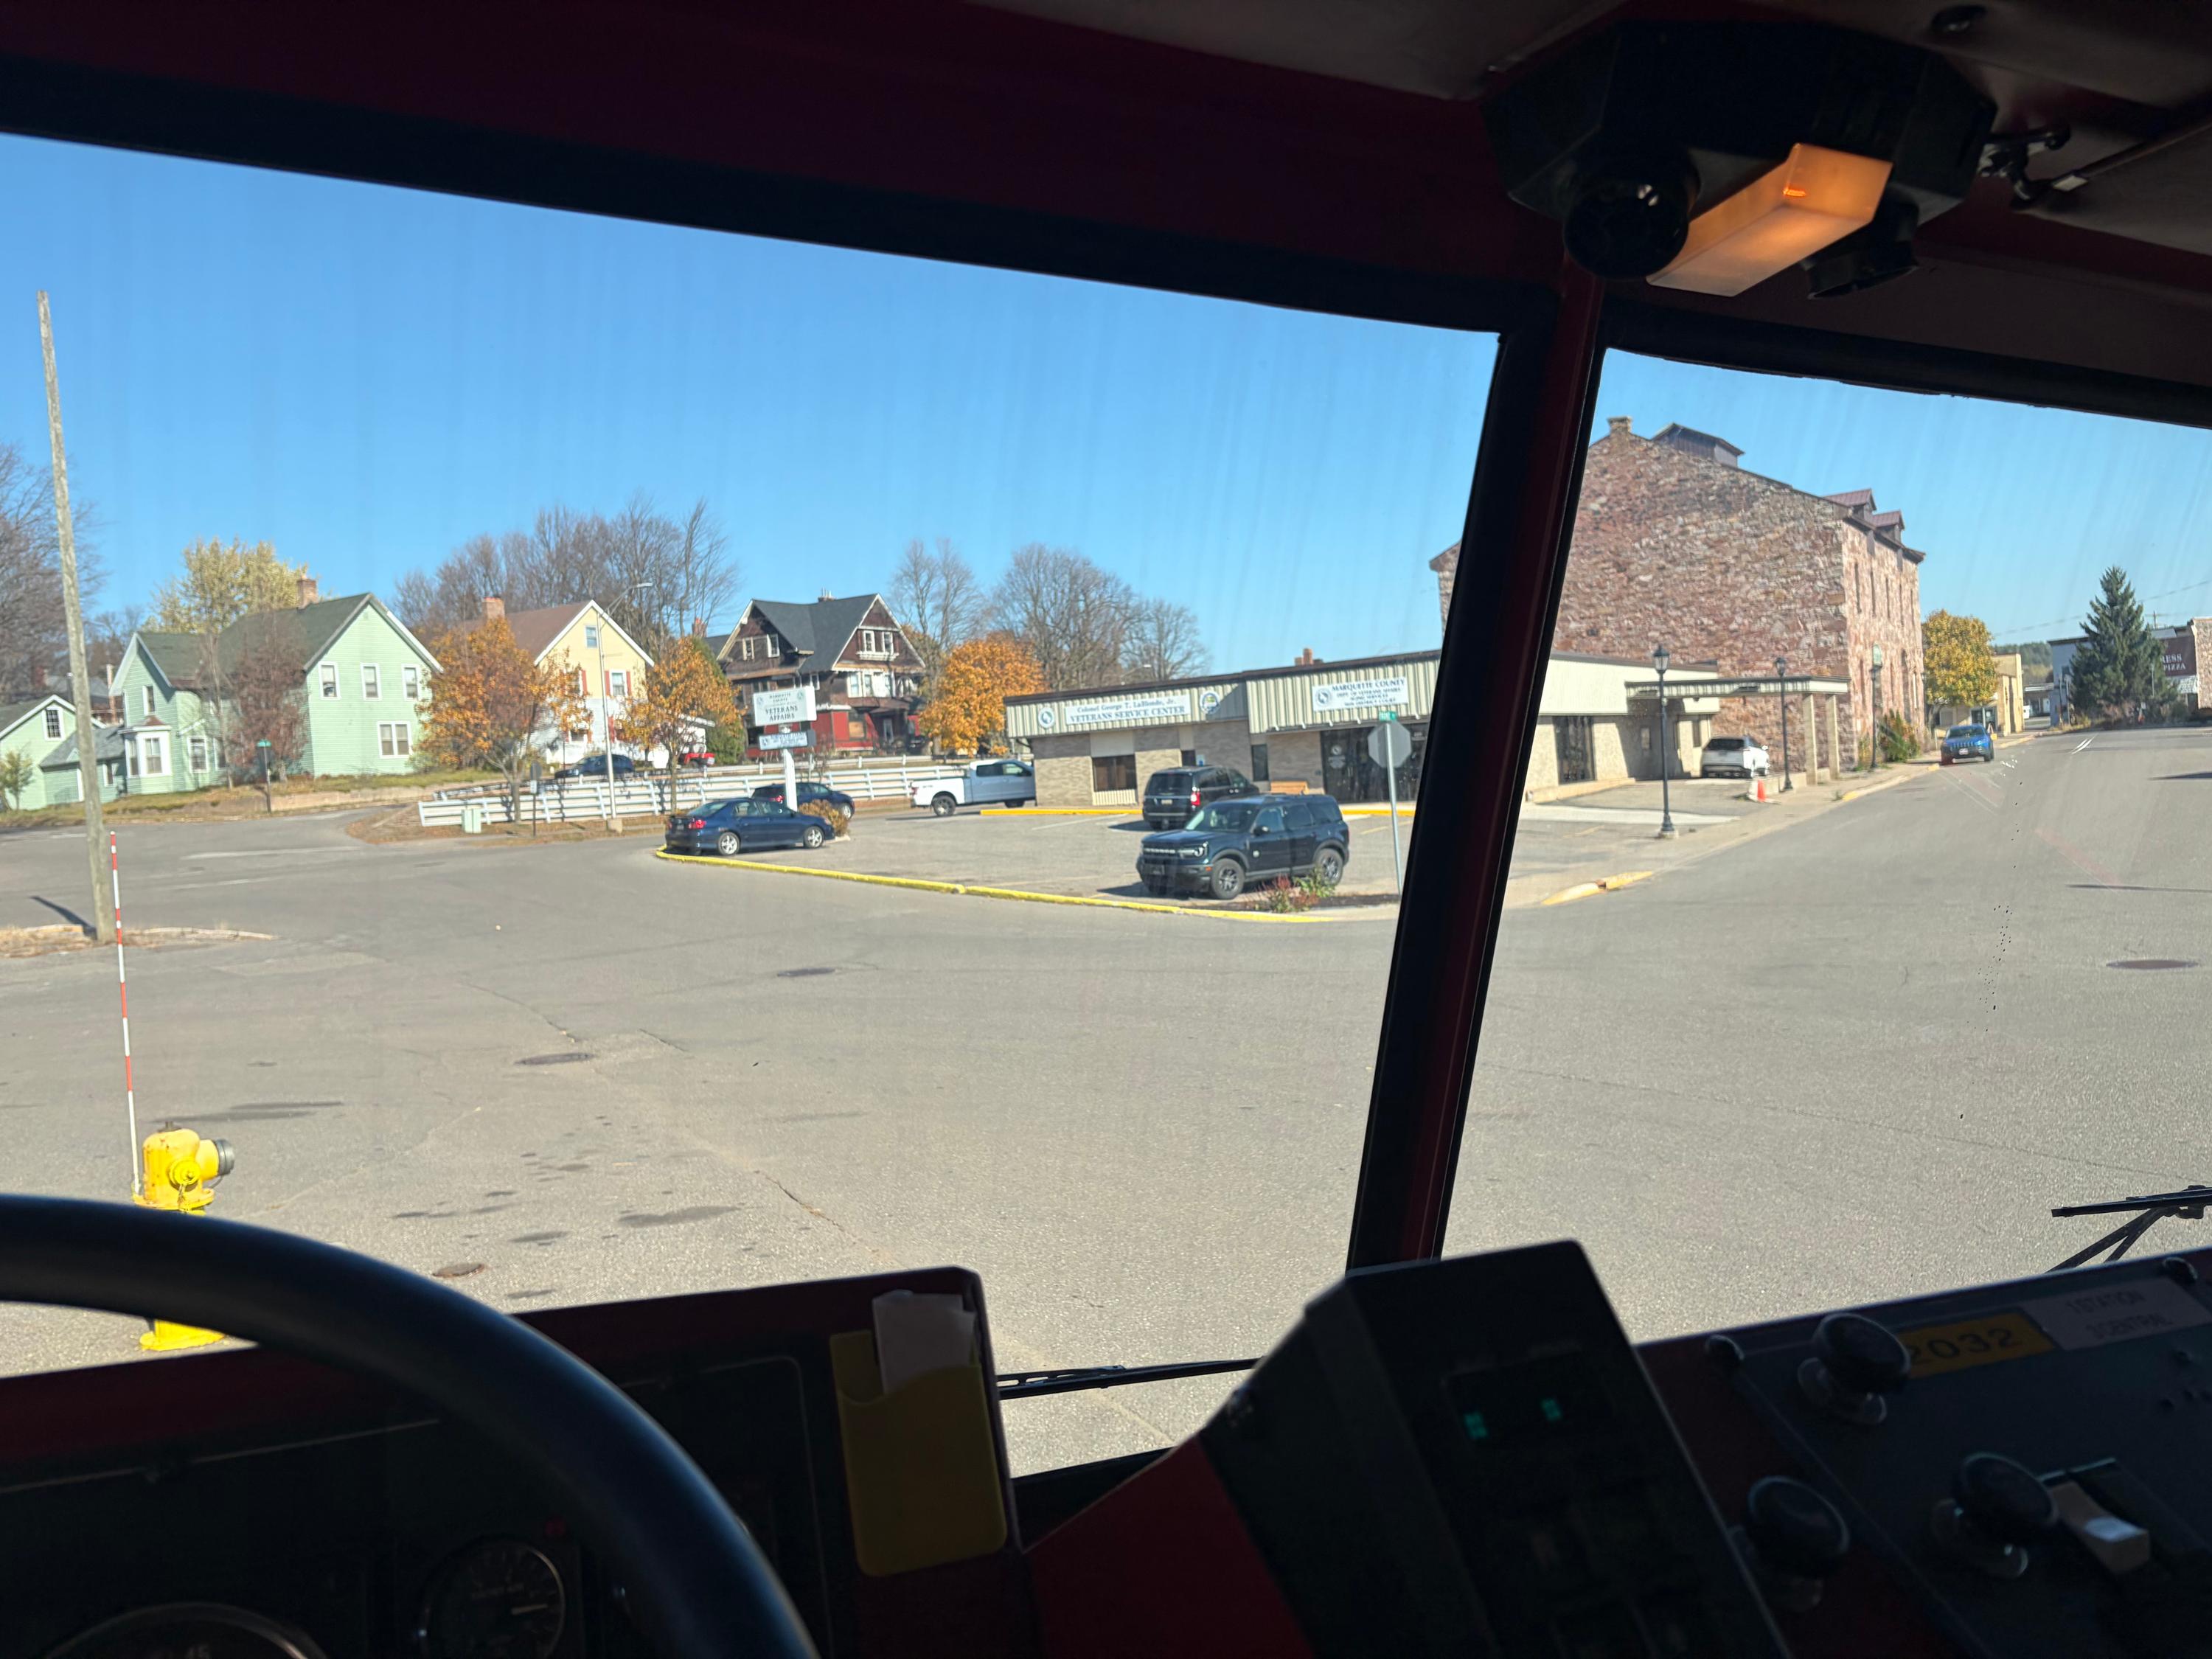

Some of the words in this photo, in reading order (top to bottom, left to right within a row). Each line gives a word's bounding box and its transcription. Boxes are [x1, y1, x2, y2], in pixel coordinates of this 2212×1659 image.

[1332, 682, 1372, 692] MARQUETTE
[1375, 679, 1405, 687] COUNTY
[765, 705, 798, 714] VETERANS
[1077, 705, 1099, 713] Colonel
[1102, 703, 1121, 712] George
[770, 713, 795, 722] AFFAIRS
[1070, 712, 1113, 723] VETERANS
[1114, 709, 1150, 718] SERVICE
[1151, 706, 1186, 715] CENTER
[1906, 1327, 2022, 1365] 2032
